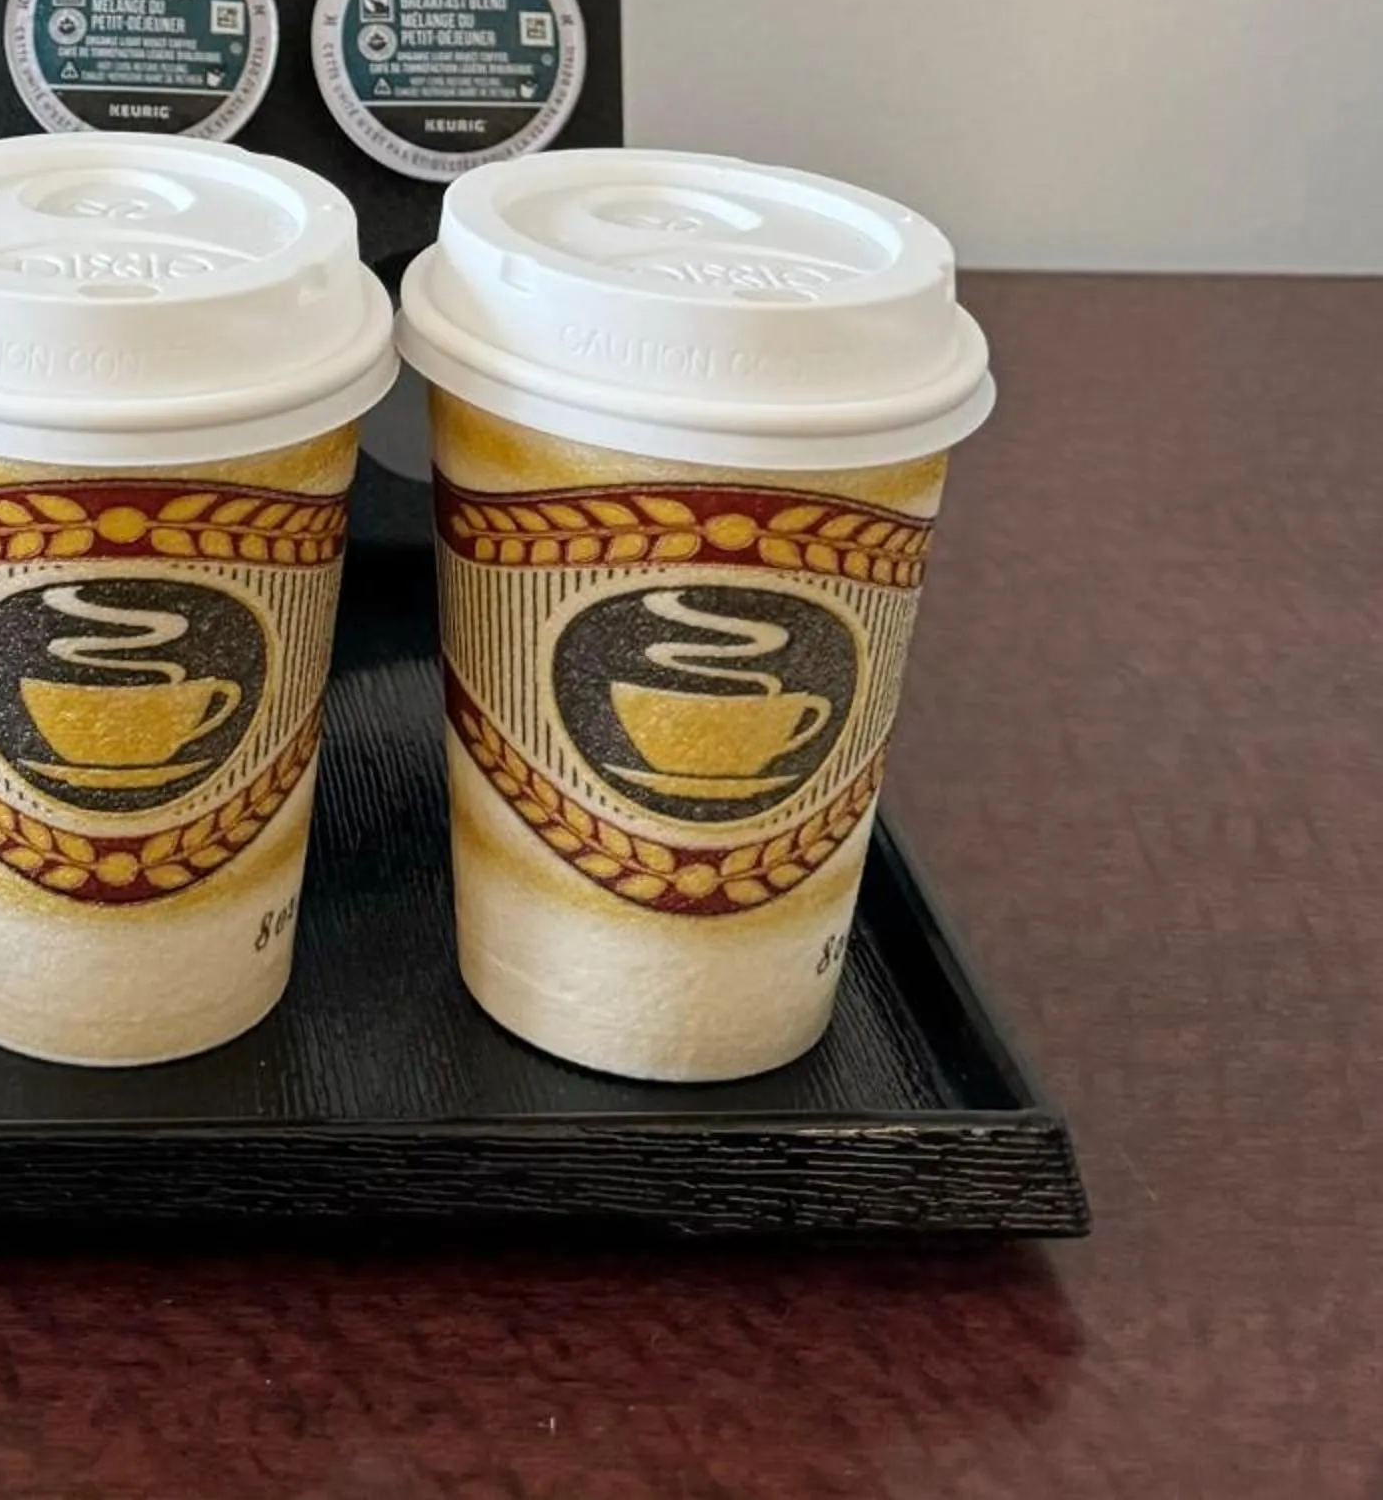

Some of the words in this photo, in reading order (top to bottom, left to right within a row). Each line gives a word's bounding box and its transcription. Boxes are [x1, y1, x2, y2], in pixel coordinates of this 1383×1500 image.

[399, 11, 456, 28] MÉLANGE
[109, 103, 170, 118] KEURIG
[425, 117, 487, 133] KEURIG
[559, 323, 716, 380] CAUTION
